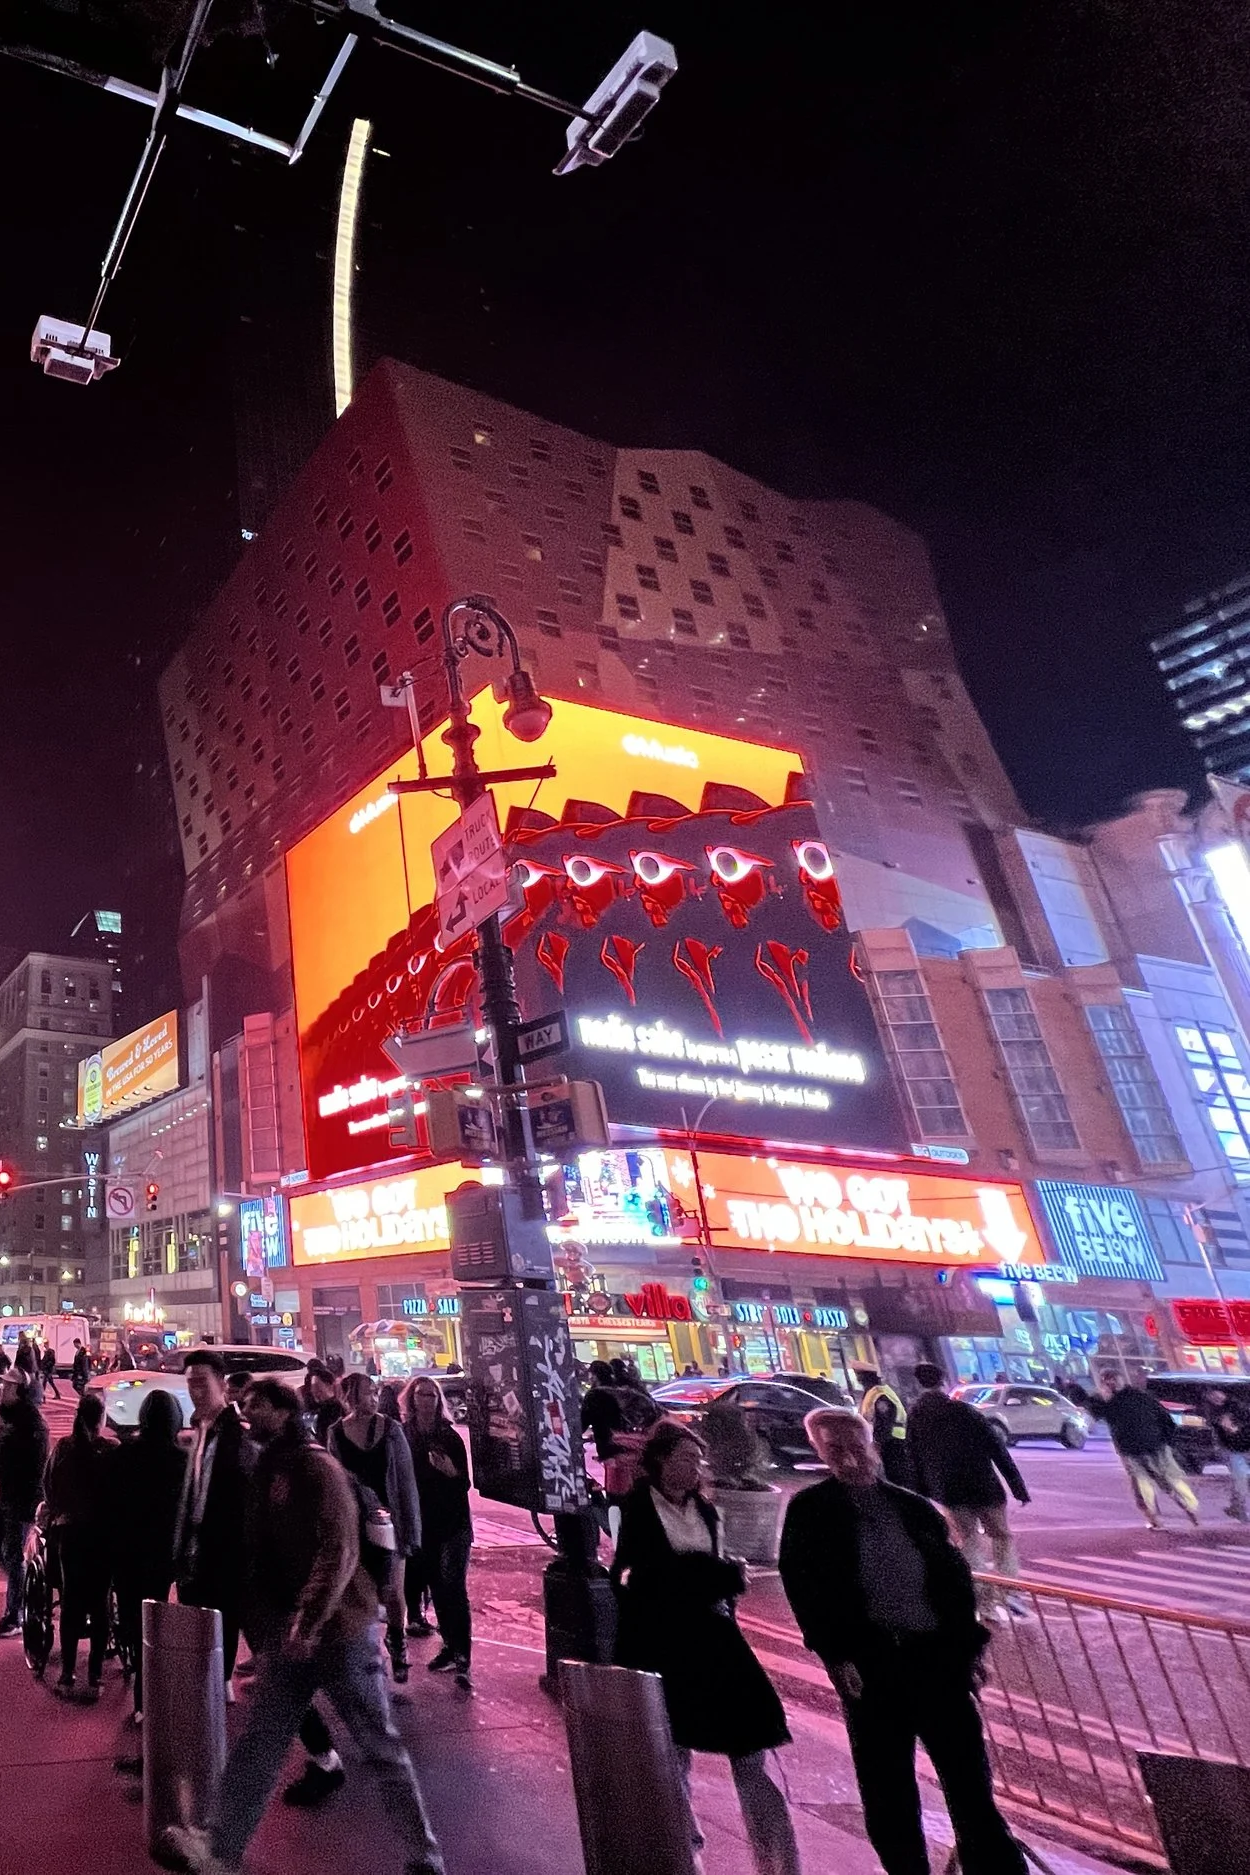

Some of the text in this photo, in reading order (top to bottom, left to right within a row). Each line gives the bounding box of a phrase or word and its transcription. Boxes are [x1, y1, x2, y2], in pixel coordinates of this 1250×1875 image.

[464, 807, 493, 842] TRUCK
[468, 834, 497, 864] ROUTE
[472, 876, 501, 905] LOCAL
[524, 1028, 554, 1050] WAY
[134, 1063, 146, 1076] FOR
[154, 1039, 173, 1060] YEARS
[85, 1152, 99, 1218] WESTIN
[1075, 1236, 1147, 1266] BELOW
[403, 1299, 427, 1315] PIZZA
[624, 1282, 692, 1320] villa
[813, 1308, 849, 1330] PASTA
